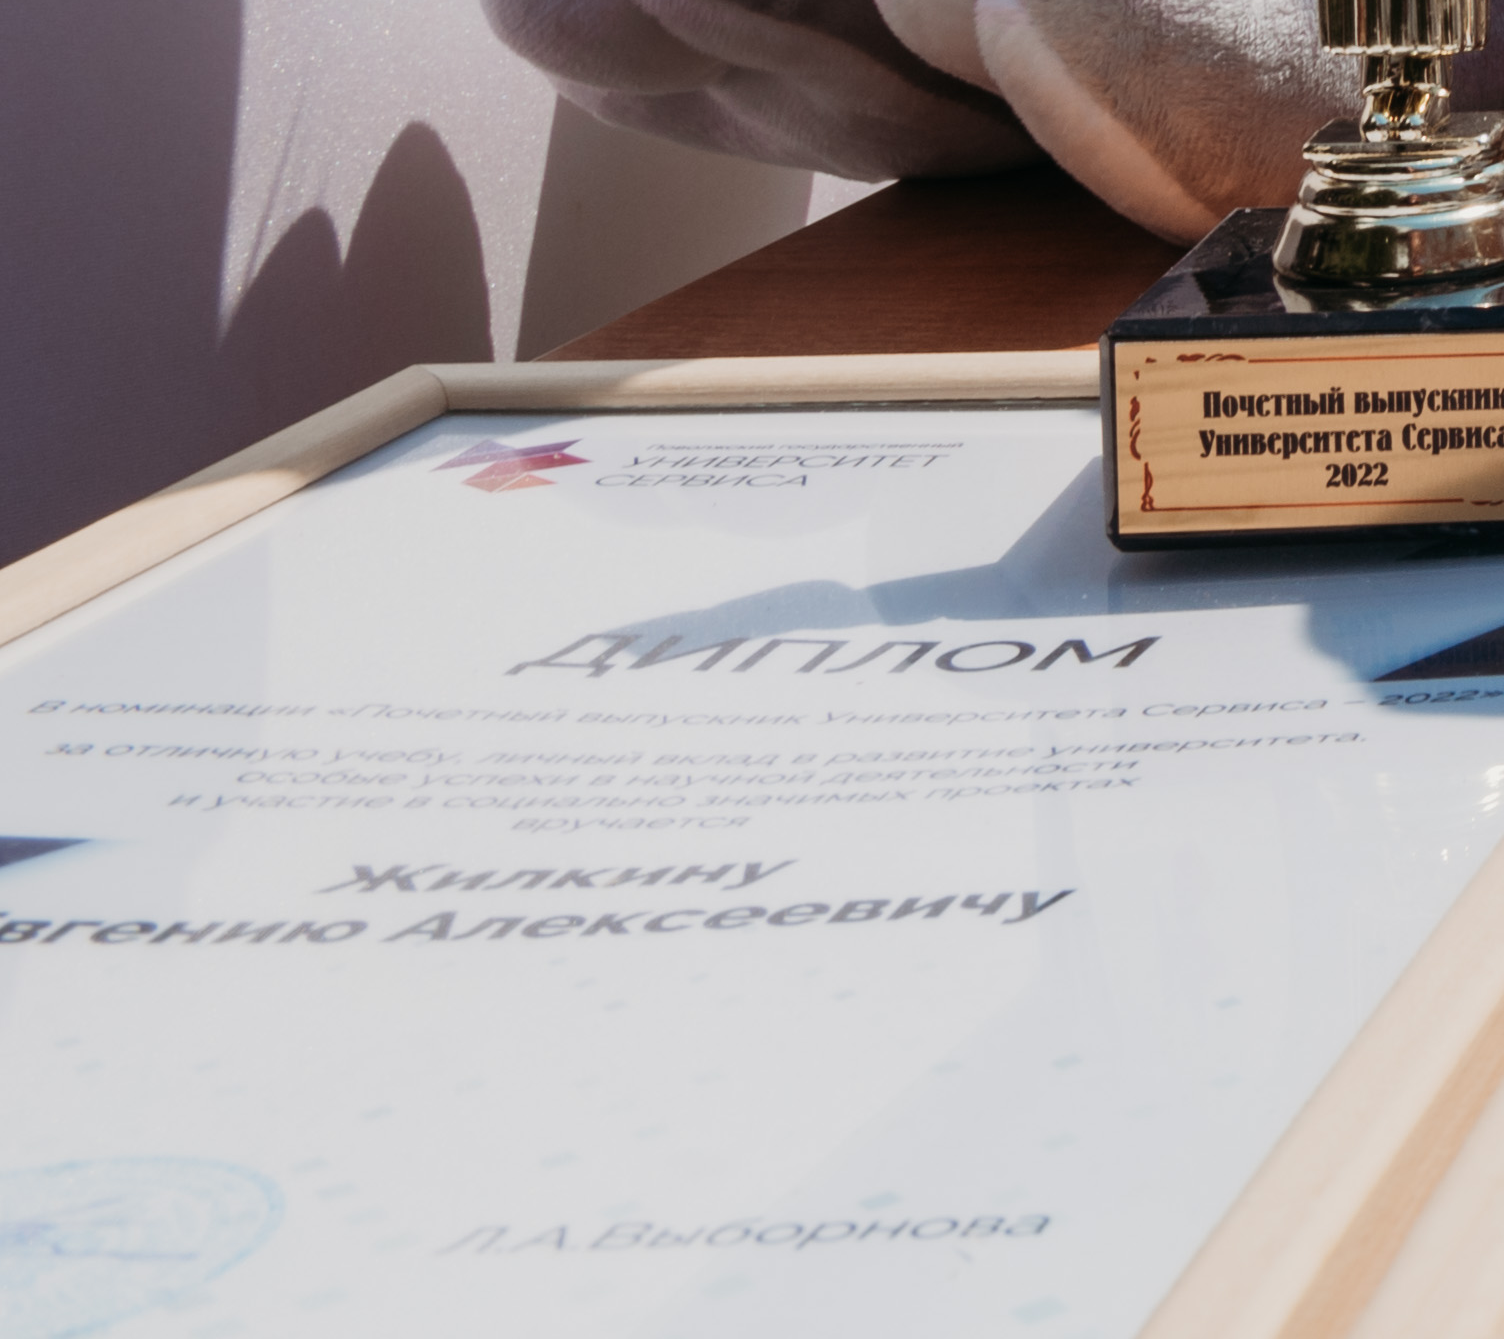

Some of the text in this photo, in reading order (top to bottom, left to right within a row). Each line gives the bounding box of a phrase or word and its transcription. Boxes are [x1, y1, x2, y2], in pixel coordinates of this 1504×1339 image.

[1203, 386, 1345, 419] Почетный
[1199, 427, 1392, 459] Университета
[623, 454, 948, 469] УНИВЕРСИТЕТ
[1325, 462, 1389, 488] 2022
[595, 474, 808, 488] СЕРВИСА
[503, 633, 1162, 678] ДИПЛОМ
[27, 699, 69, 715] В
[71, 700, 316, 719] номинации
[576, 709, 808, 728] выпускник
[823, 704, 1127, 727] Университета
[1142, 696, 1328, 719] Сервиса
[44, 741, 95, 757] за
[104, 743, 319, 766] отличную
[482, 750, 643, 767] личный
[652, 750, 778, 767] вклад
[791, 750, 822, 765] в
[831, 743, 1035, 768] развитие
[237, 759, 1139, 790] особые успехи в научной деятельности
[167, 776, 1141, 812] и участие в социально значимых проектах
[510, 815, 751, 833] вручается
[312, 858, 798, 893] Жилкину
[0, 888, 1077, 944] вгению Алексеевичу
